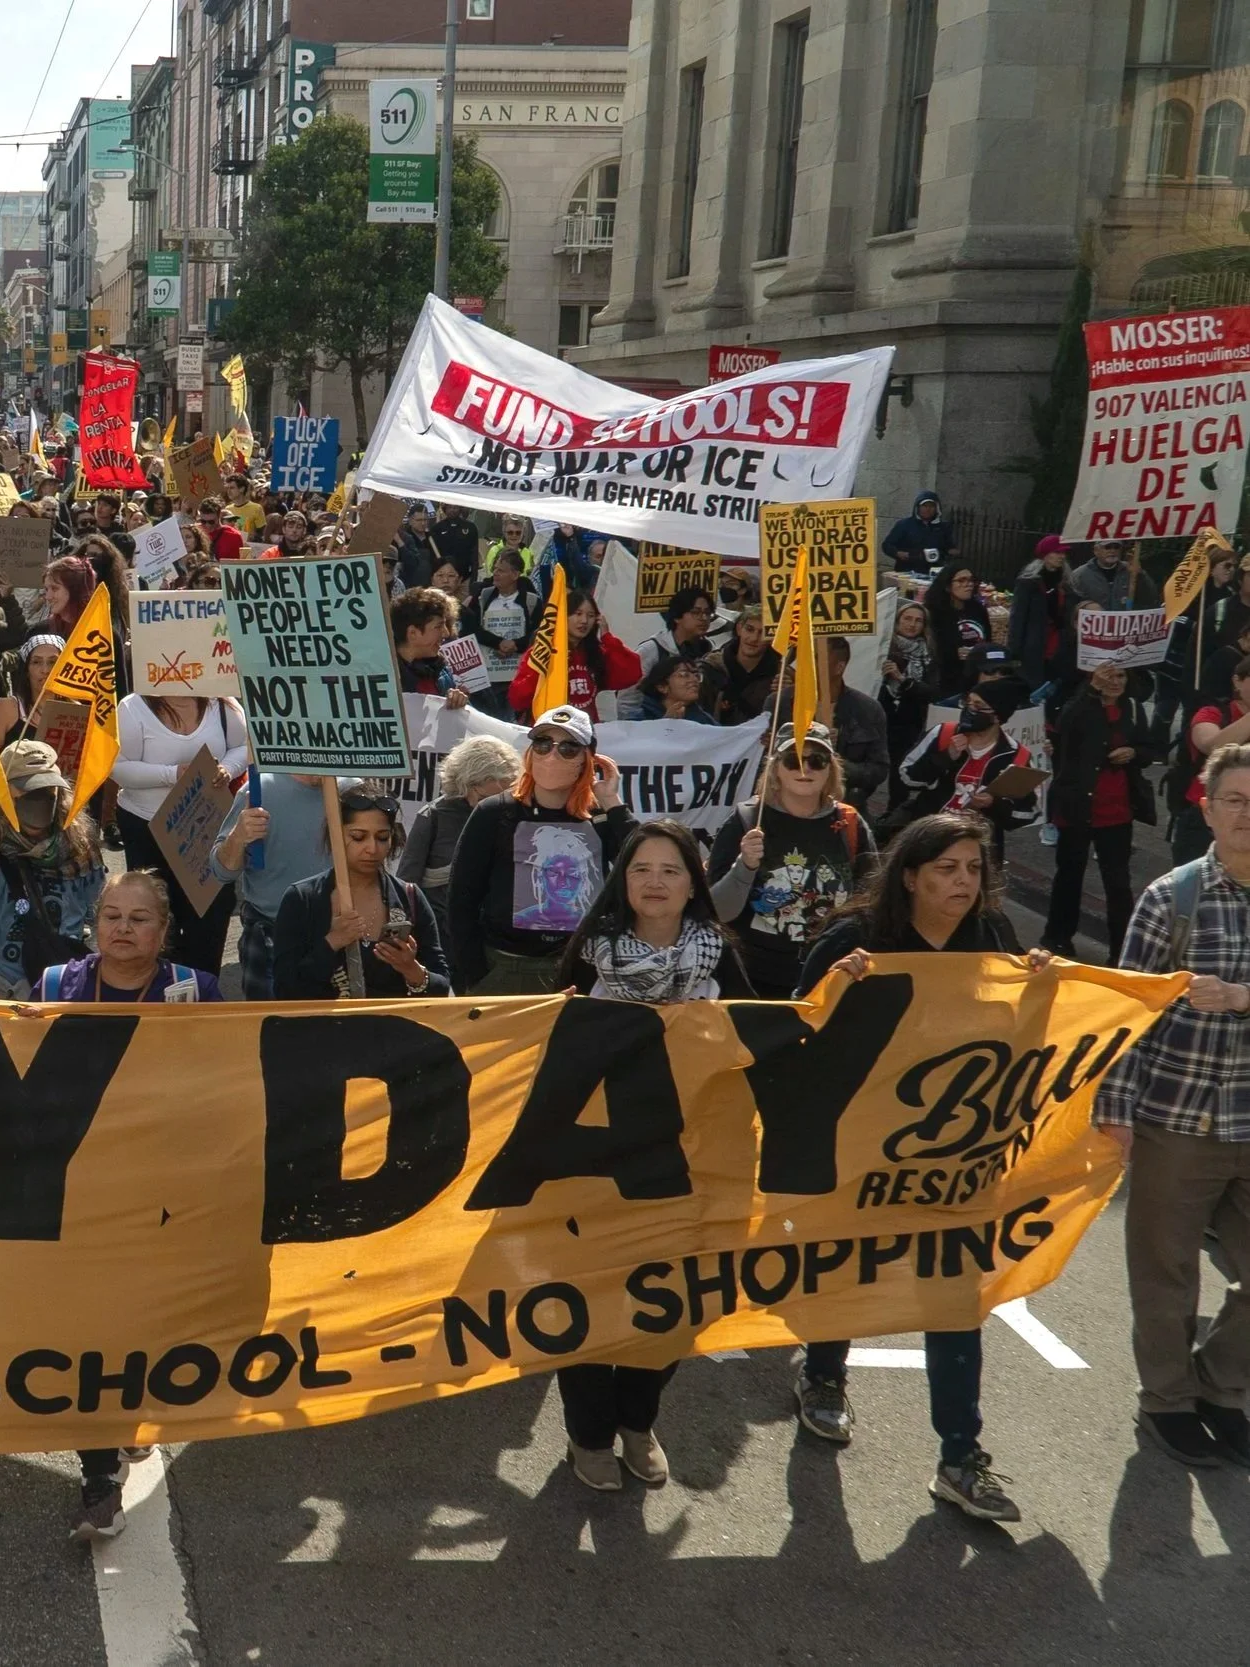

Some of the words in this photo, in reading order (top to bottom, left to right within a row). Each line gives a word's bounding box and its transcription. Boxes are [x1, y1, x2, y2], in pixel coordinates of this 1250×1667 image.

[380, 109, 407, 124] 511
[462, 104, 513, 121] SAN
[528, 106, 620, 123] FRANC
[383, 170, 406, 179] Getting
[408, 171, 420, 179] you
[384, 160, 396, 168] 511
[406, 160, 422, 168] Bay:
[388, 190, 399, 198] Bay
[406, 206, 426, 214] 511.org
[154, 288, 166, 296] 511
[1110, 315, 1223, 352] MOSSER:
[1091, 356, 1134, 379] ¡Hable
[1136, 358, 1160, 371] con
[1162, 355, 1183, 368] sus
[1184, 344, 1250, 366] inquilinos!
[91, 403, 108, 417] LA
[1094, 394, 1136, 420] 907
[1140, 380, 1246, 414] VALENCIA
[454, 376, 574, 450] FUND
[584, 382, 818, 446] SCHOOLS!
[85, 416, 126, 438] RENTA
[284, 416, 329, 444] FUCK
[1089, 414, 1244, 468] HUELGA
[287, 443, 318, 467] OFF
[479, 440, 536, 475] NOT
[554, 450, 630, 476] WAR
[643, 446, 688, 481] OR
[701, 446, 764, 491] ICE
[278, 467, 326, 492] ICE
[436, 465, 534, 492] STUDENTS
[540, 477, 578, 502] FOR
[584, 482, 598, 500] A
[602, 482, 698, 515] GENERAL
[1136, 463, 1188, 502] DE
[766, 510, 789, 518] TRUMP
[766, 518, 788, 532] WE
[792, 515, 839, 530] WON'T
[843, 514, 867, 526] LET
[1086, 502, 1218, 540] RENTA
[766, 532, 806, 548] YOU
[813, 526, 868, 546] DRAG
[642, 562, 674, 572] NOT
[678, 559, 715, 568] WAR
[767, 550, 800, 569] US
[809, 544, 869, 567] INTO
[224, 566, 306, 600] MONEY
[317, 562, 372, 597] FOR
[642, 572, 667, 594] W/
[674, 570, 714, 592] IRAN
[237, 598, 368, 635] PEOPLE'S
[265, 634, 352, 668] NEEDS
[244, 676, 309, 718] NOT
[321, 674, 394, 718] THE
[570, 678, 589, 695] PSL
[252, 722, 302, 748] WAR
[306, 722, 401, 748] MACHINE
[260, 752, 285, 764] PARTY
[286, 752, 300, 763] FOR
[302, 753, 343, 764] SOCIALISM
[352, 754, 400, 765] LIBERATION
[621, 764, 684, 813] THE
[689, 758, 747, 810] BAY
[882, 1027, 1132, 1163] Bay
[260, 972, 914, 1245] DAY
[442, 1281, 590, 1368] NO
[626, 1196, 1054, 1336] SHOPPING
